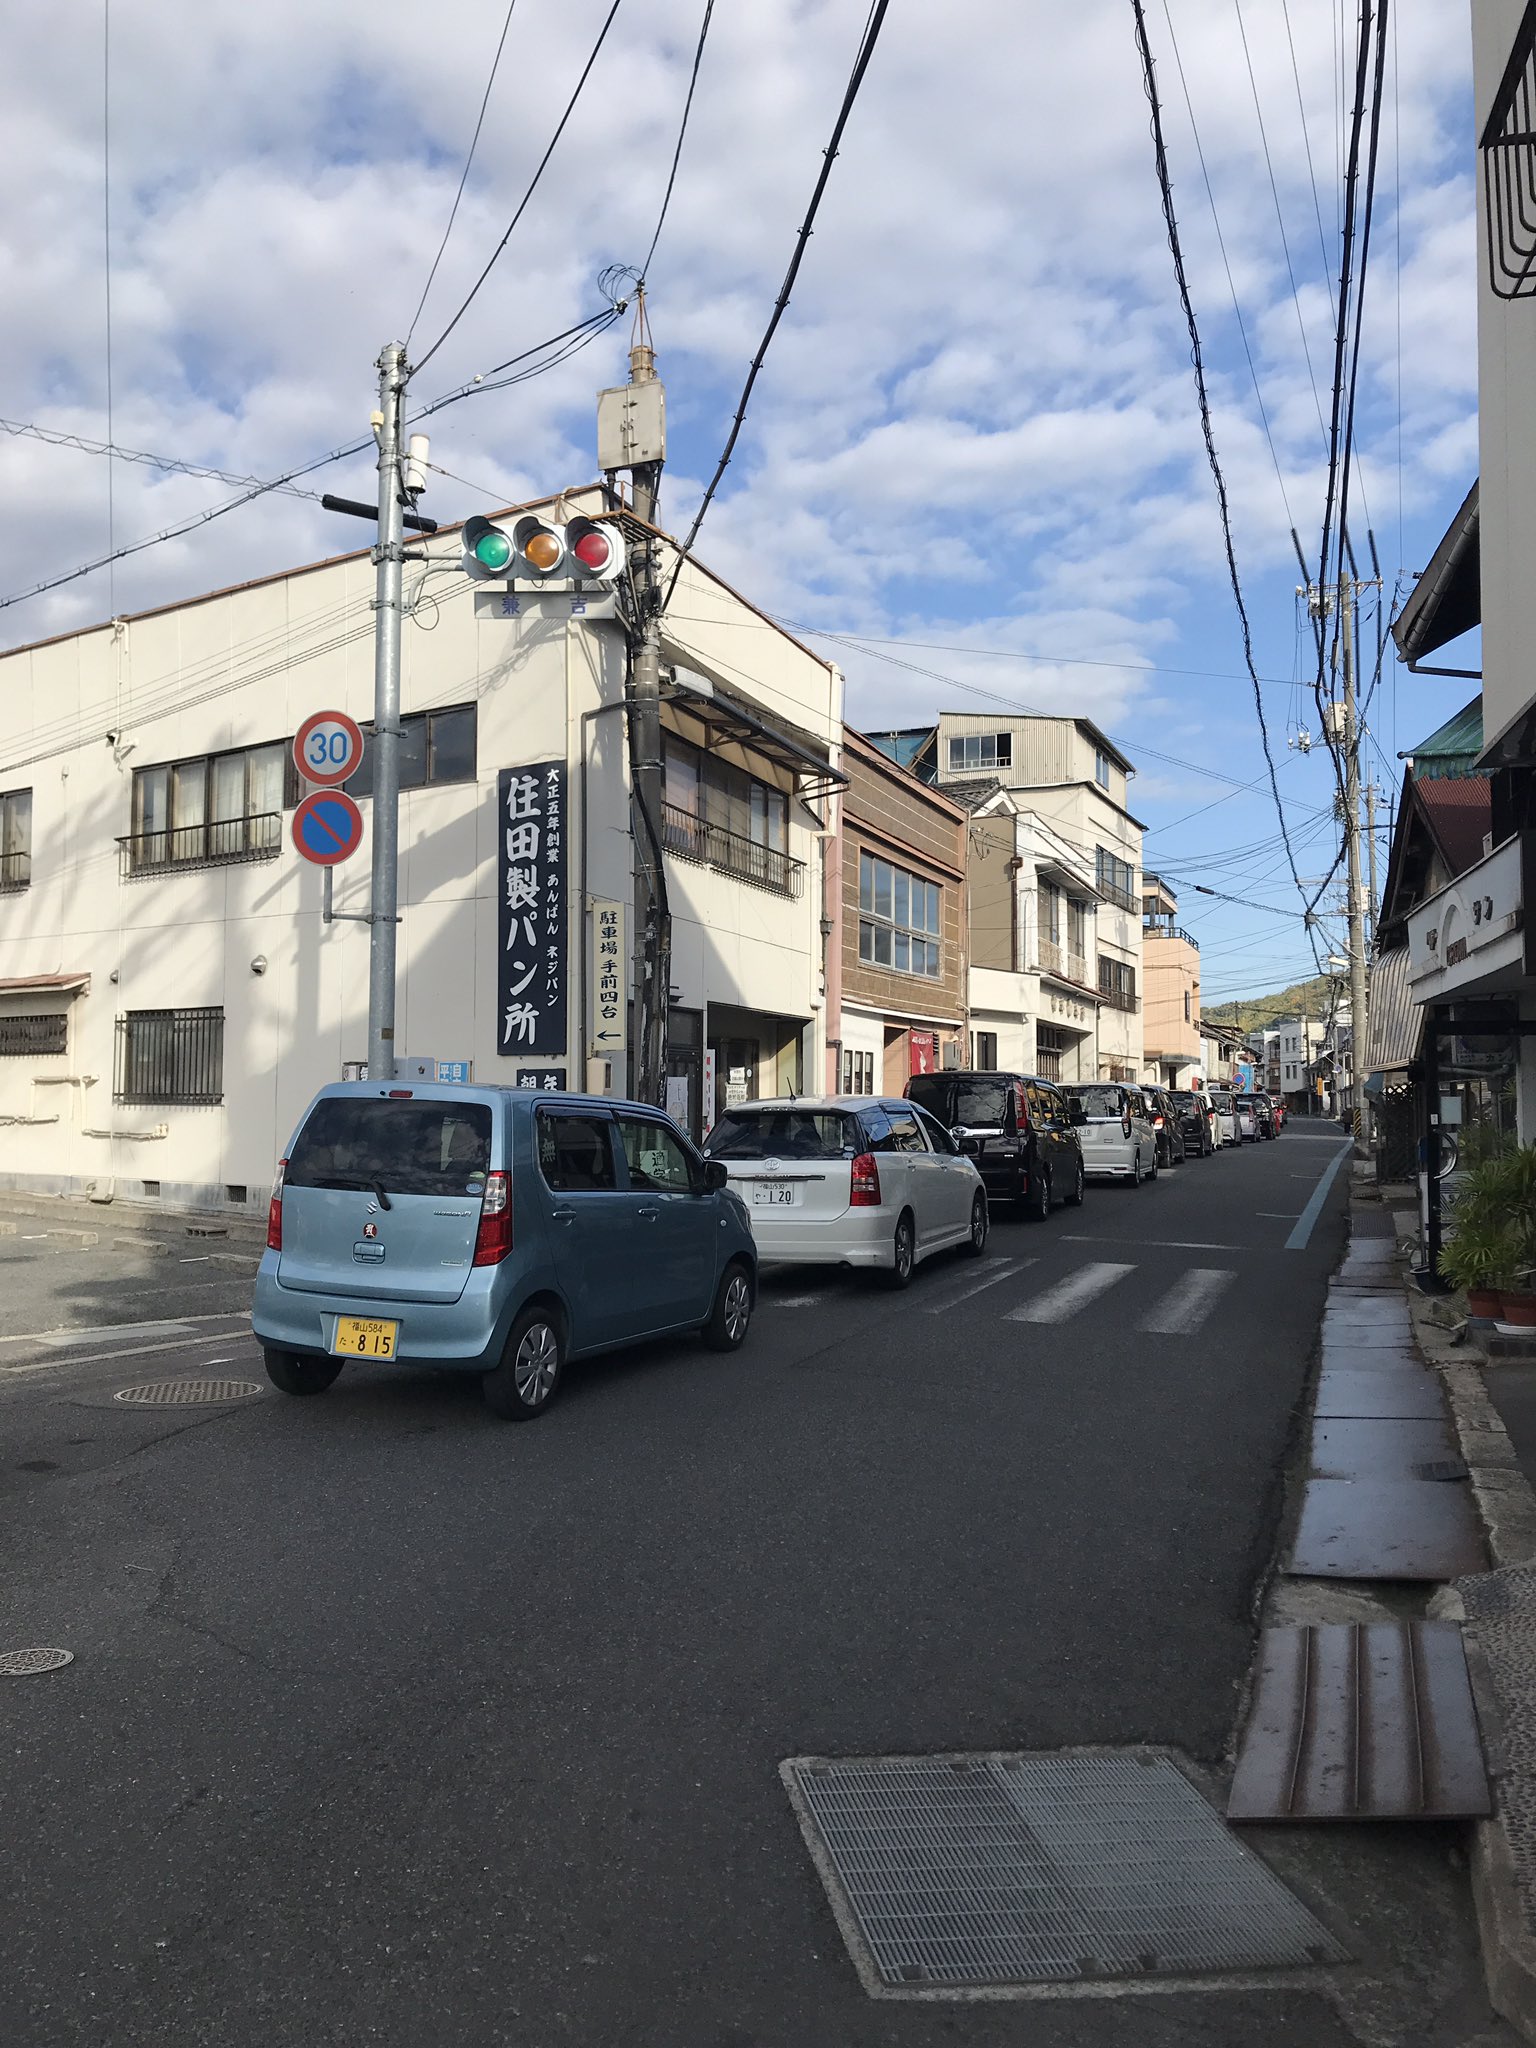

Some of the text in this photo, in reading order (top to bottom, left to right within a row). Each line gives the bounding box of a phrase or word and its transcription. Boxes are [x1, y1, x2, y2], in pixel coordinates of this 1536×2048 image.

[310, 732, 347, 764] 30
[503, 776, 541, 1045] 住田製パン所
[546, 768, 560, 1007] 大正五年創業 あんぱん ネジパン
[600, 911, 618, 1019] 駐車場 手前四台
[352, 1321, 383, 1333] 福山584
